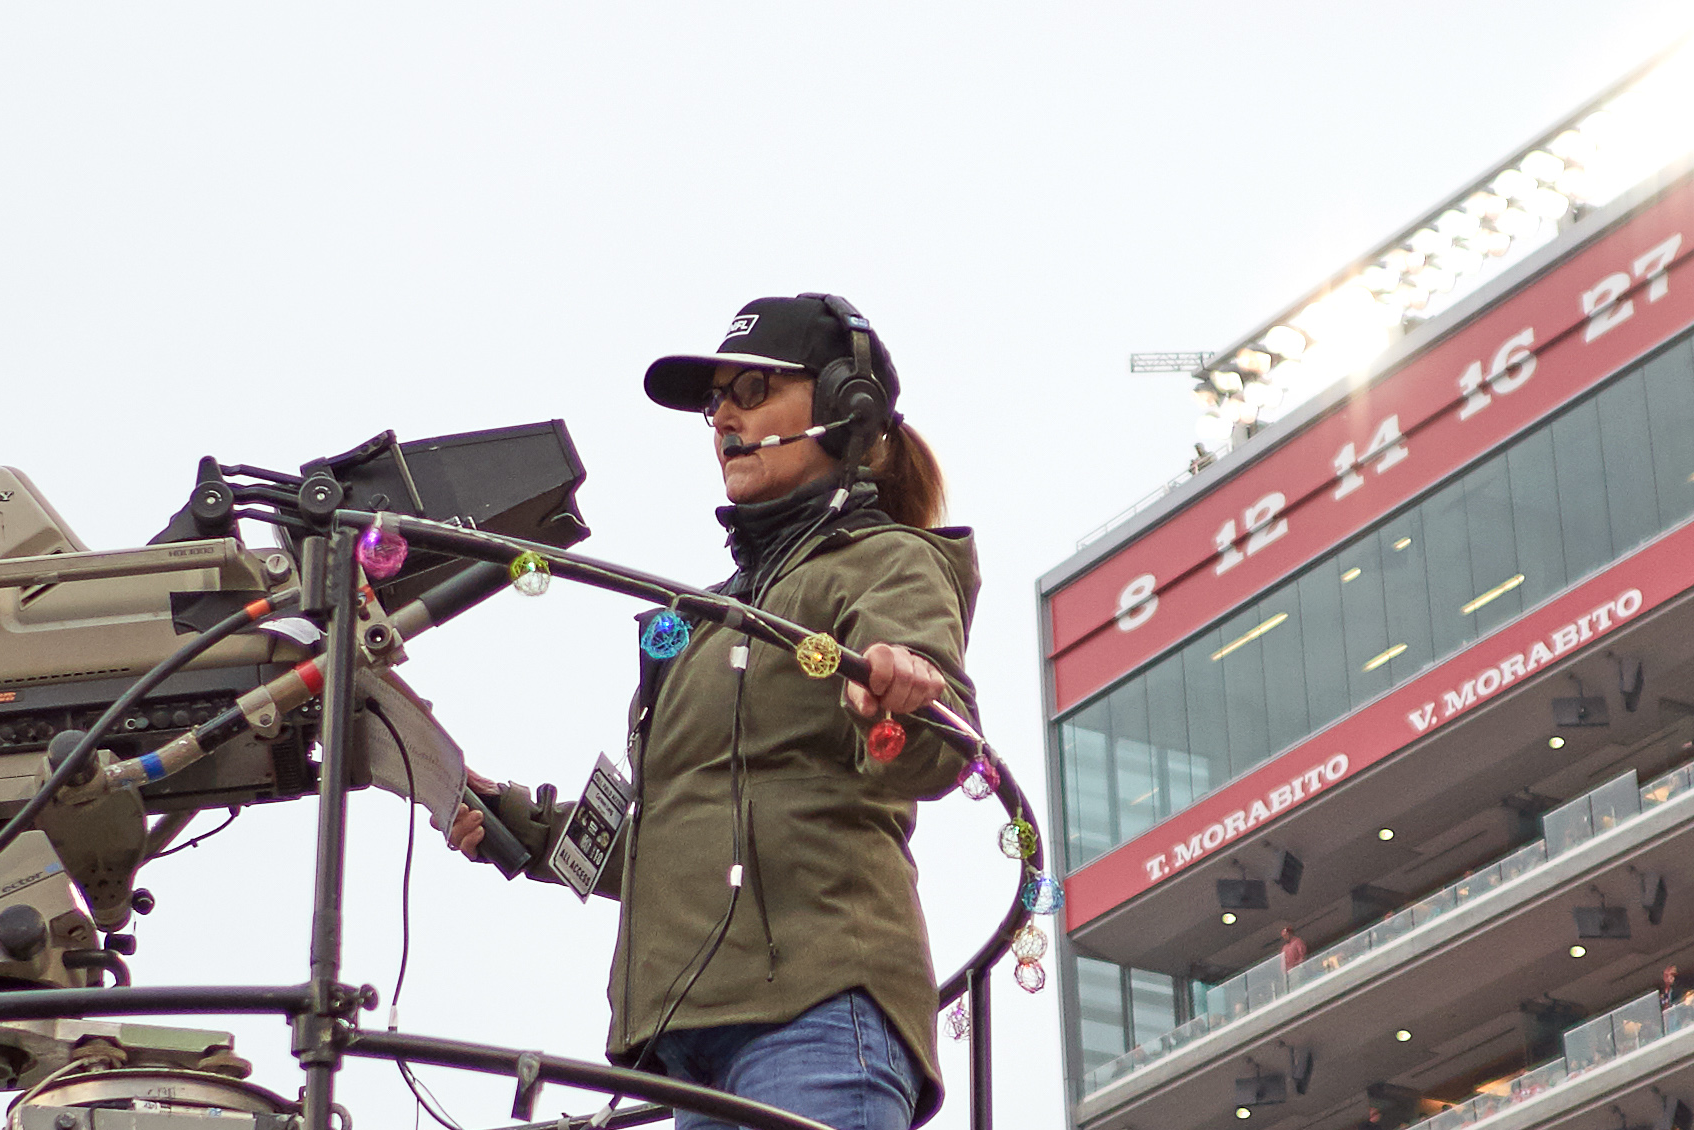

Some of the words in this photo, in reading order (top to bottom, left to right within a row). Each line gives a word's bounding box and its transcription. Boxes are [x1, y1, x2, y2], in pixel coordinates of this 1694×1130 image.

[1116, 573, 1159, 632] 8
[1214, 491, 1289, 577] 12
[1332, 413, 1409, 501] 14
[1459, 327, 1537, 421] 16
[1582, 232, 1683, 344] 27
[1409, 702, 1439, 732] V.
[1443, 588, 1644, 718] MORABITO
[559, 848, 570, 867] ALL
[569, 858, 591, 888] ACCESS
[1146, 853, 1171, 882] T.
[1173, 753, 1350, 868] MORABITO
